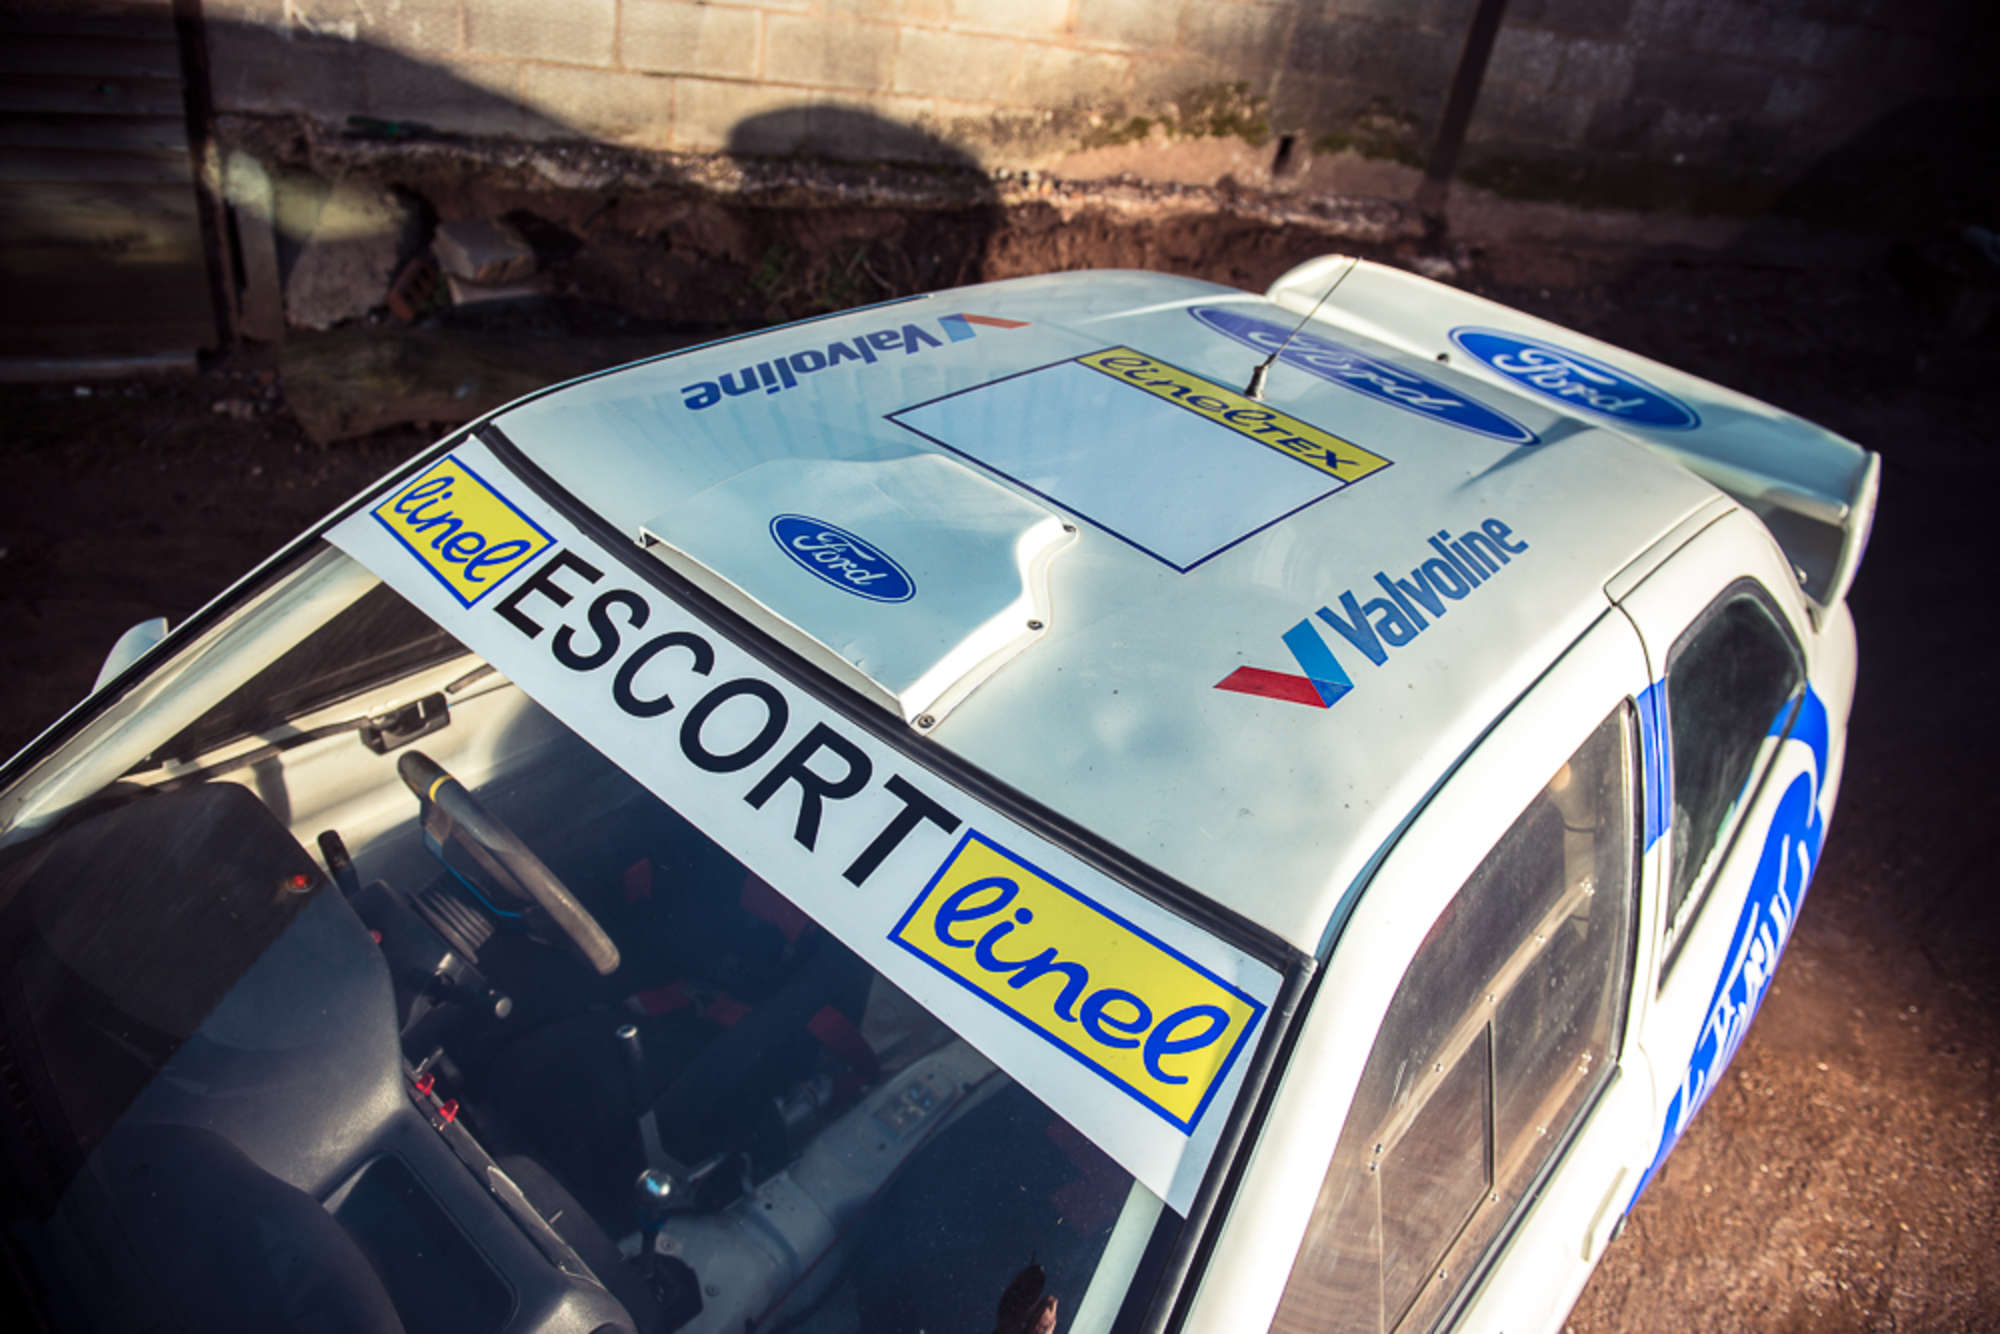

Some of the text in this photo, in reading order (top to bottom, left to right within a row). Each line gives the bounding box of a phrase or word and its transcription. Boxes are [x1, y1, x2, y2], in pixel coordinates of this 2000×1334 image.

[681, 323, 943, 411] Valvoline
[1248, 329, 1462, 412] Ford
[1491, 346, 1647, 416] Ford
[393, 475, 532, 583] linel
[792, 531, 887, 586] Ford
[1316, 516, 1529, 666] Valvoline
[493, 548, 963, 889] ESCORT
[934, 876, 1231, 1085] linel
